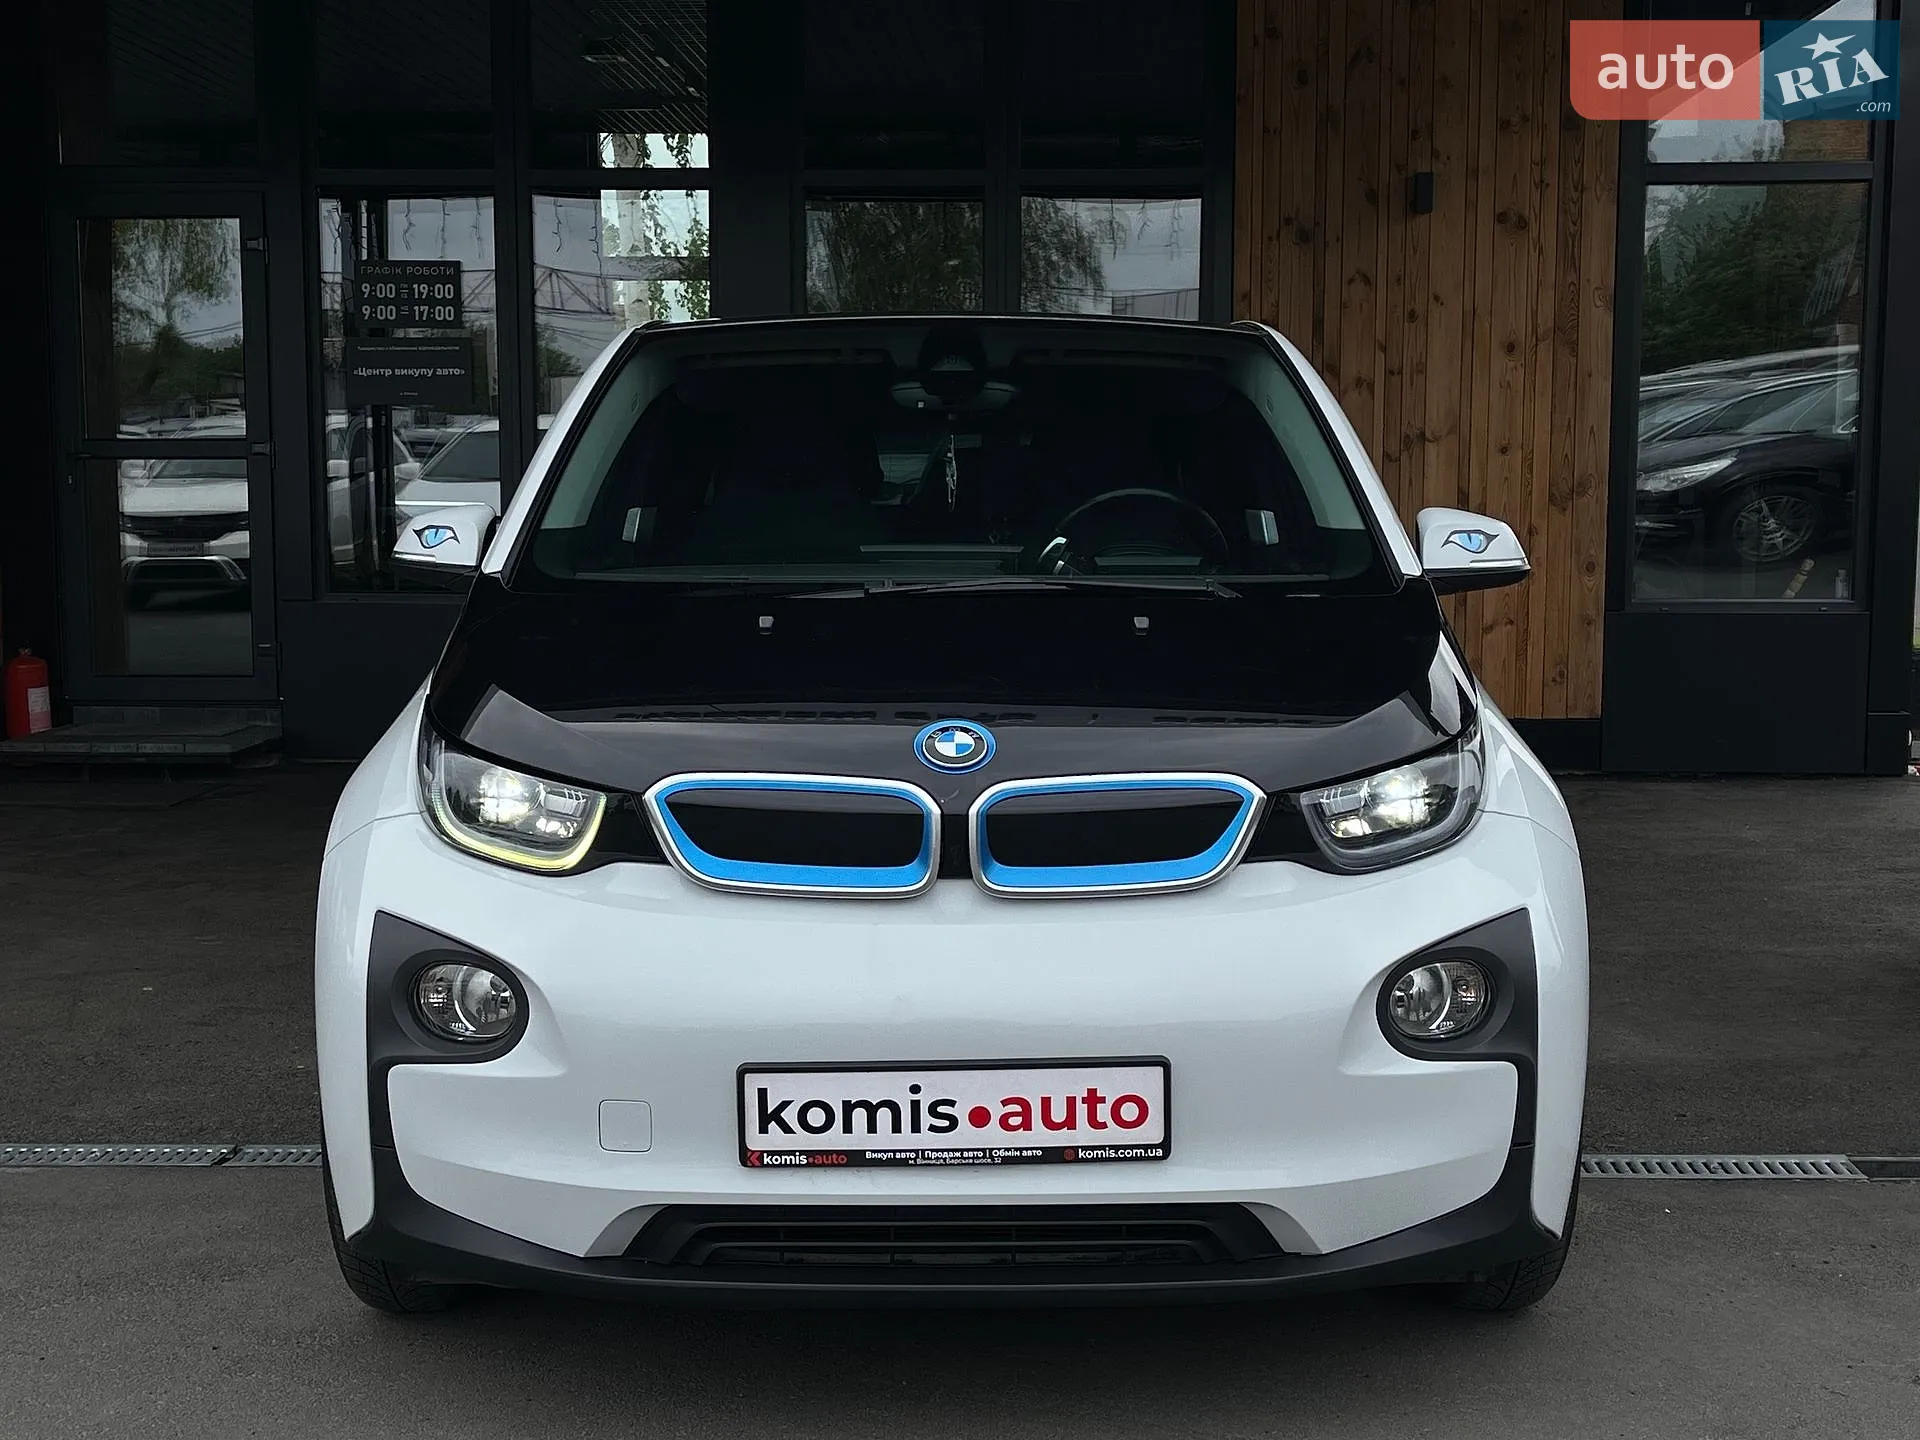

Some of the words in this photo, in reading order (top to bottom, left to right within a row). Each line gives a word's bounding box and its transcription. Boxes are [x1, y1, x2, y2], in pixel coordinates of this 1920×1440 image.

[360, 266, 402, 275] ГРАФІК
[406, 266, 454, 275] РОБОТИ
[361, 283, 396, 298] 9:00
[413, 283, 454, 299] 19:00
[361, 305, 396, 320] 9:00
[413, 305, 455, 320] 17:00
[395, 368, 433, 377] викупу
[865, 1151, 894, 1160] Викуп
[924, 1150, 961, 1160] Продаж
[992, 1149, 1020, 1157] Обмін
[1079, 1146, 1163, 1159] komis.com.ua
